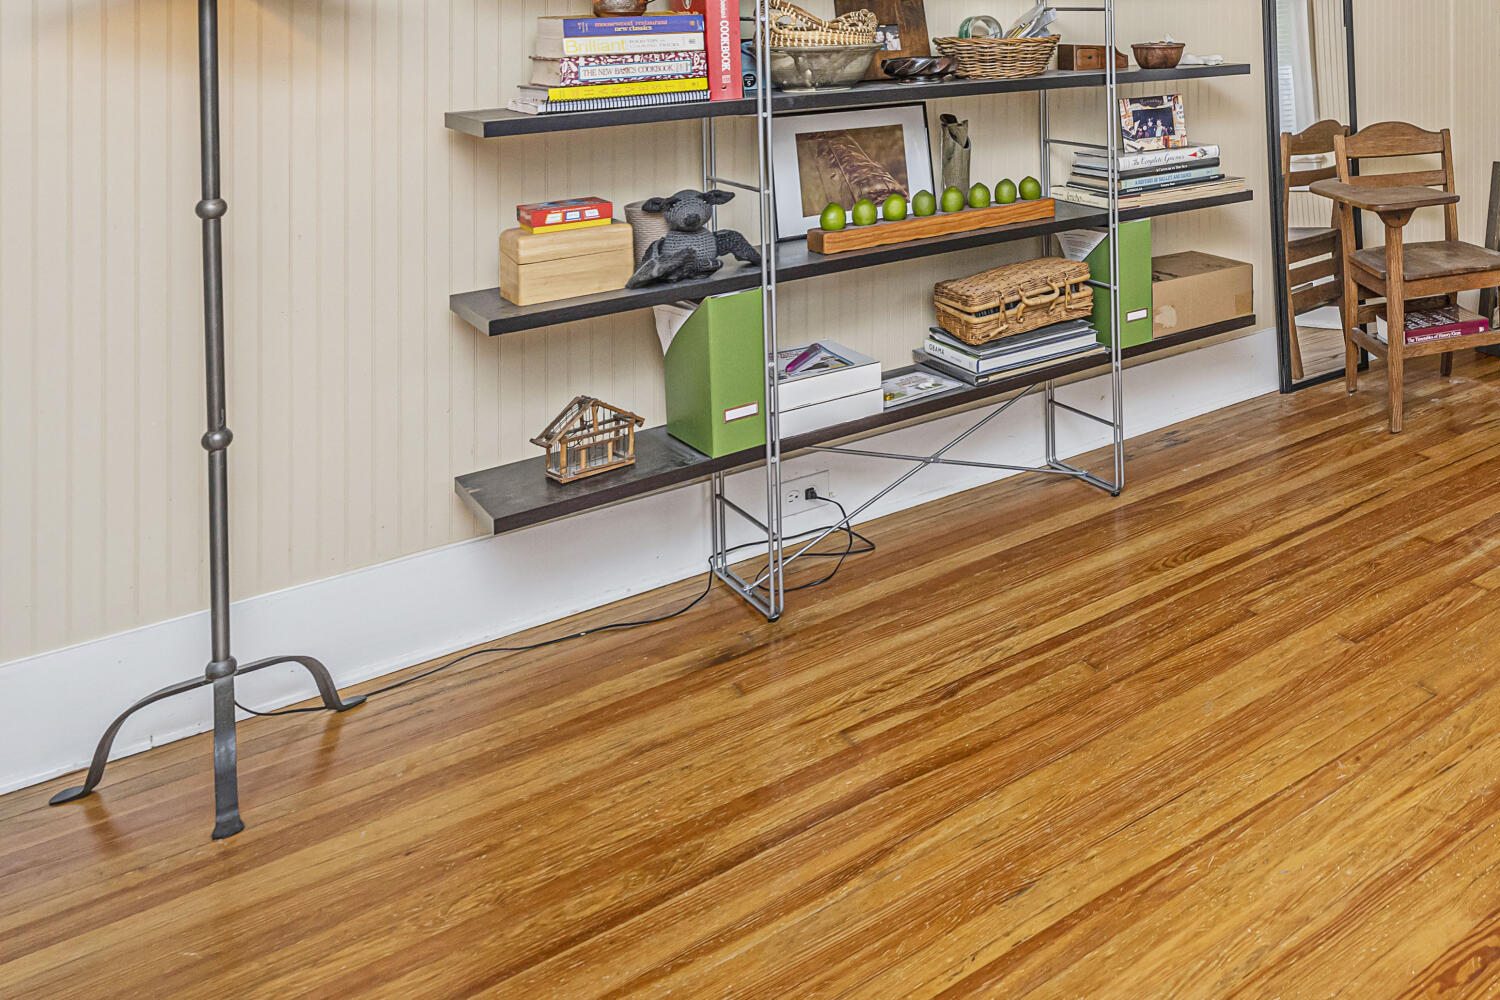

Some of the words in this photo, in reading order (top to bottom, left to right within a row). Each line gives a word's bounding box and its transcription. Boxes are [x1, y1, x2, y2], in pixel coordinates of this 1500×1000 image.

[565, 39, 626, 54] Brilliant
[720, 20, 731, 72] COOKBOOK
[583, 69, 597, 77] THE
[598, 68, 613, 76] NEW
[614, 67, 637, 75] BASICS
[638, 64, 674, 73] COOKBOOK
